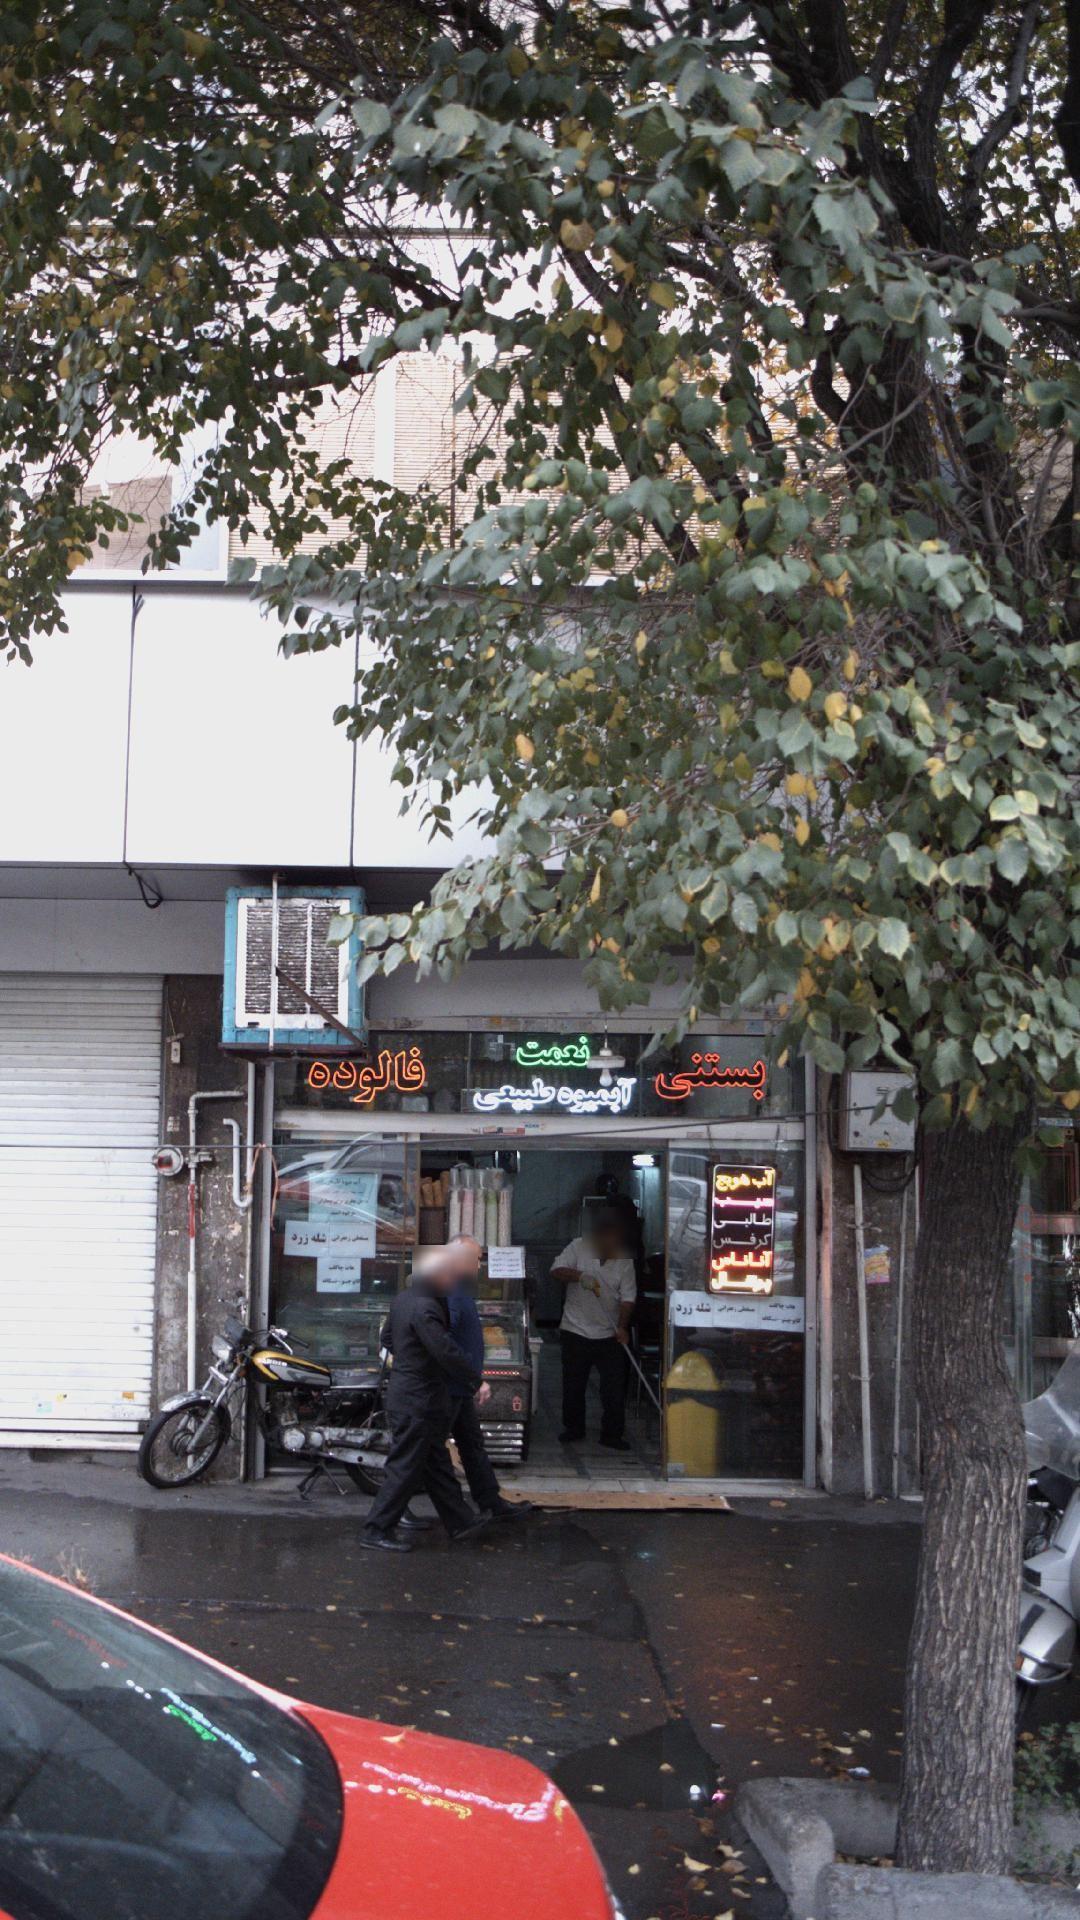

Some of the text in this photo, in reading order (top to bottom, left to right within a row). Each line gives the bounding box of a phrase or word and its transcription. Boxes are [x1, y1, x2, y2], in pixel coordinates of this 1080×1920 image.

[515, 1035, 590, 1068] نعمت
[307, 1046, 426, 1103] فالوده
[655, 1052, 767, 1101] بستنی
[473, 1078, 556, 1112] طبیعی
[715, 1168, 775, 1191] آب هویج
[714, 1212, 772, 1228] طالبی
[291, 1232, 309, 1245] زرد
[713, 1232, 772, 1249] کرفس
[711, 1250, 773, 1270] آناناس
[676, 1303, 693, 1315] زرد
